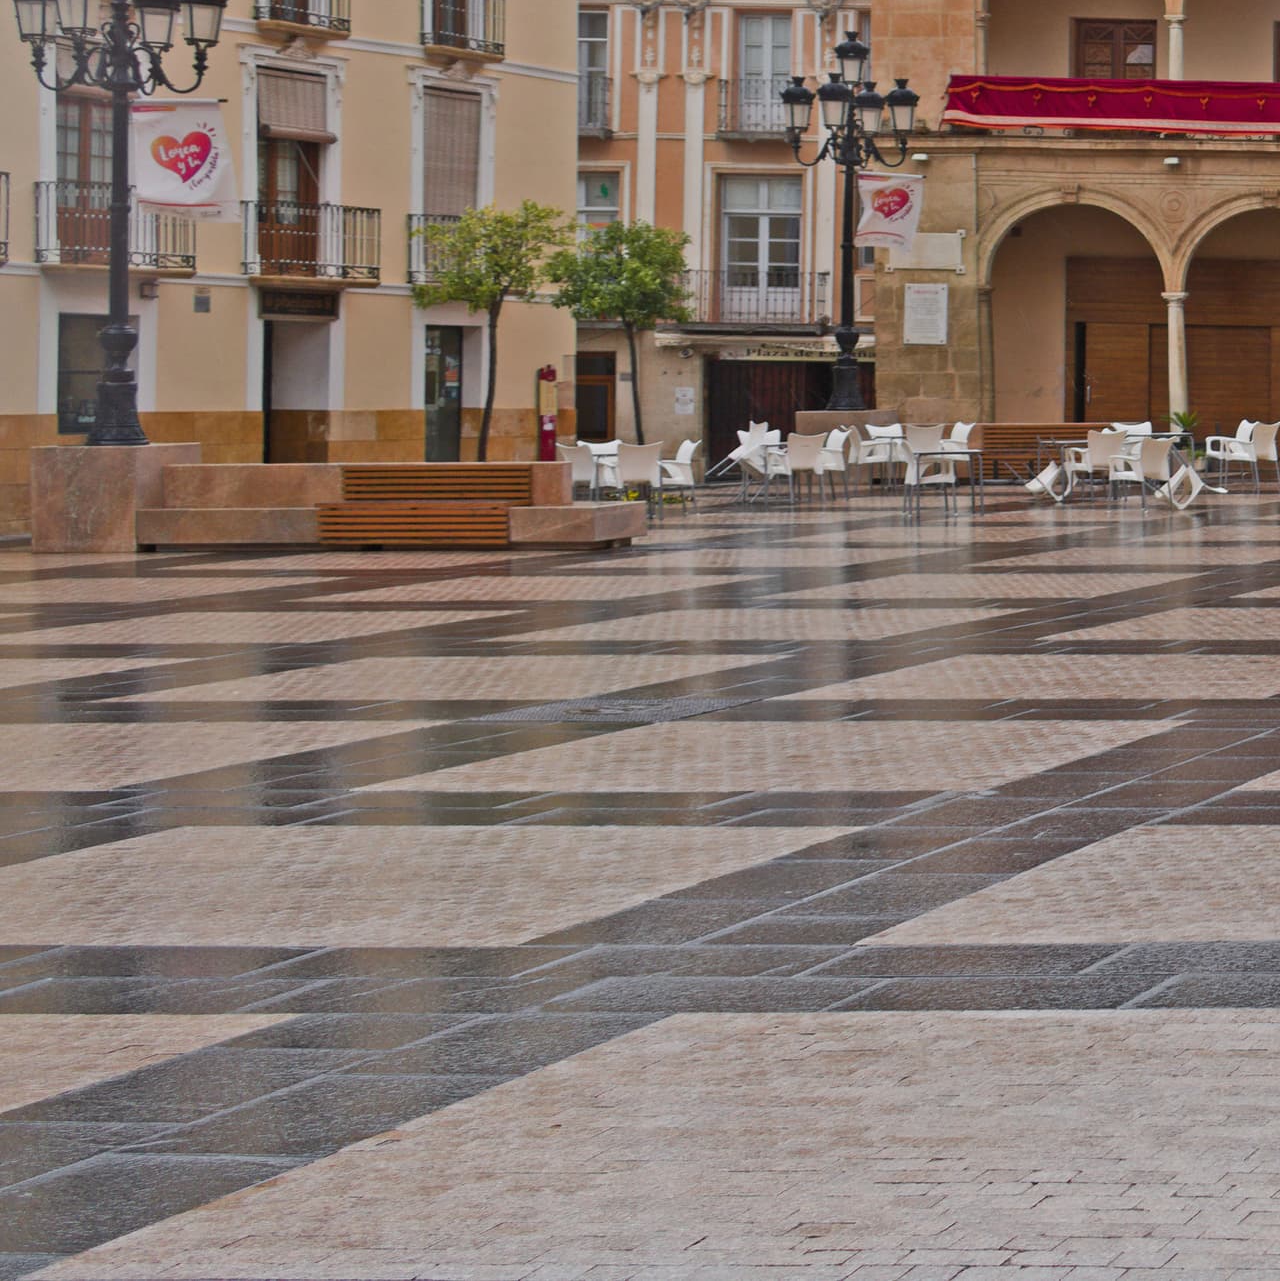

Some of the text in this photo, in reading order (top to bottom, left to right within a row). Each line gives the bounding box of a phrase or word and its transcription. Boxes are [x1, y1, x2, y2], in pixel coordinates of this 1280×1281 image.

[158, 144, 201, 162] Lorca
[177, 161, 187, 175] y
[746, 348, 876, 358] Plaza de Esña
